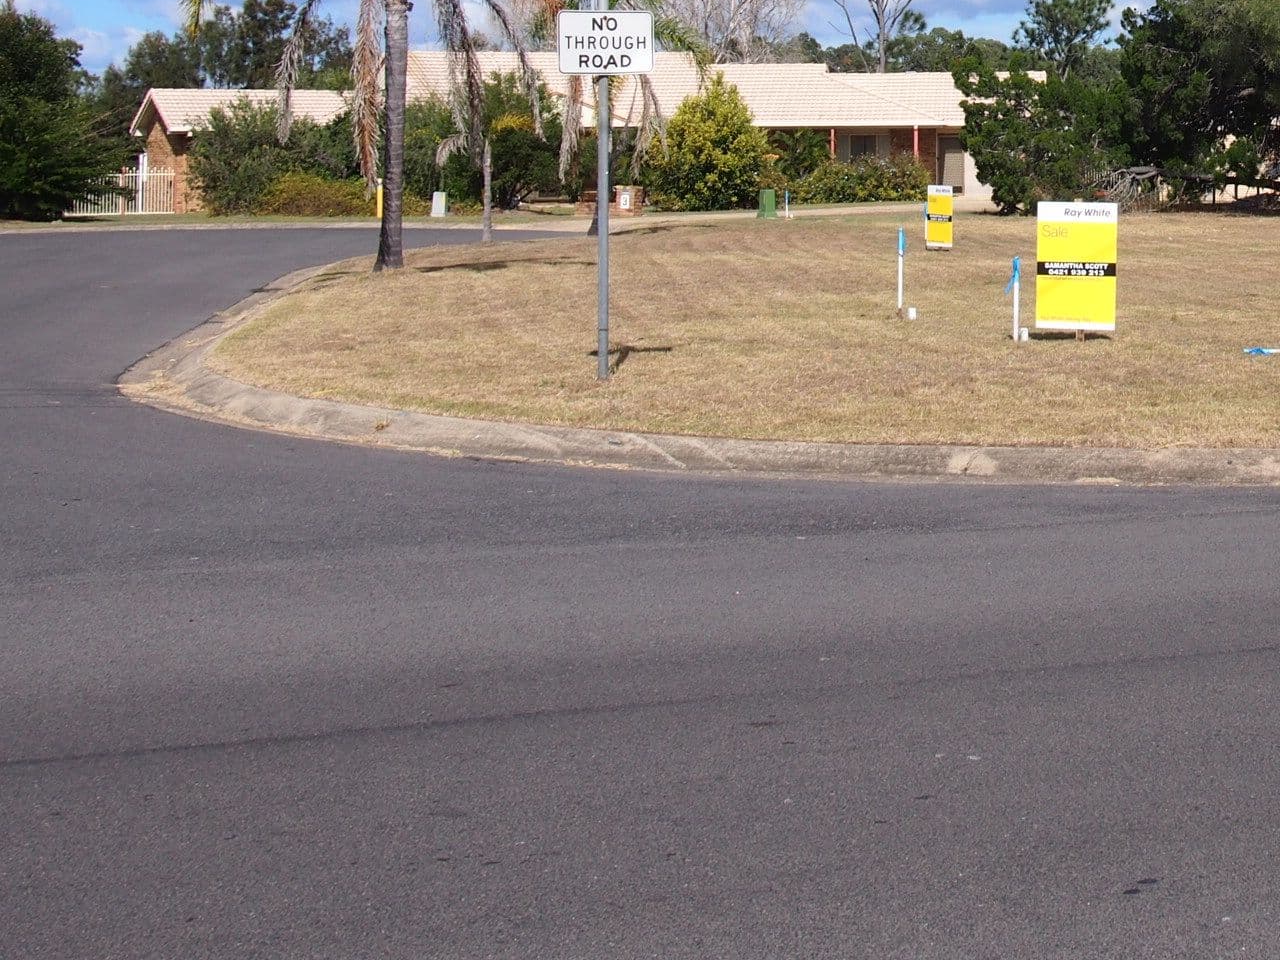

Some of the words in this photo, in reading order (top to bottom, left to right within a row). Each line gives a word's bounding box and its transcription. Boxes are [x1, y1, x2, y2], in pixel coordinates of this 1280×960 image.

[591, 17, 618, 31] NO
[565, 36, 647, 50] THROUGH
[579, 54, 632, 68] ROAD
[1064, 208, 1082, 219] Ray
[1084, 208, 1111, 218] White
[1042, 224, 1069, 238] Sale
